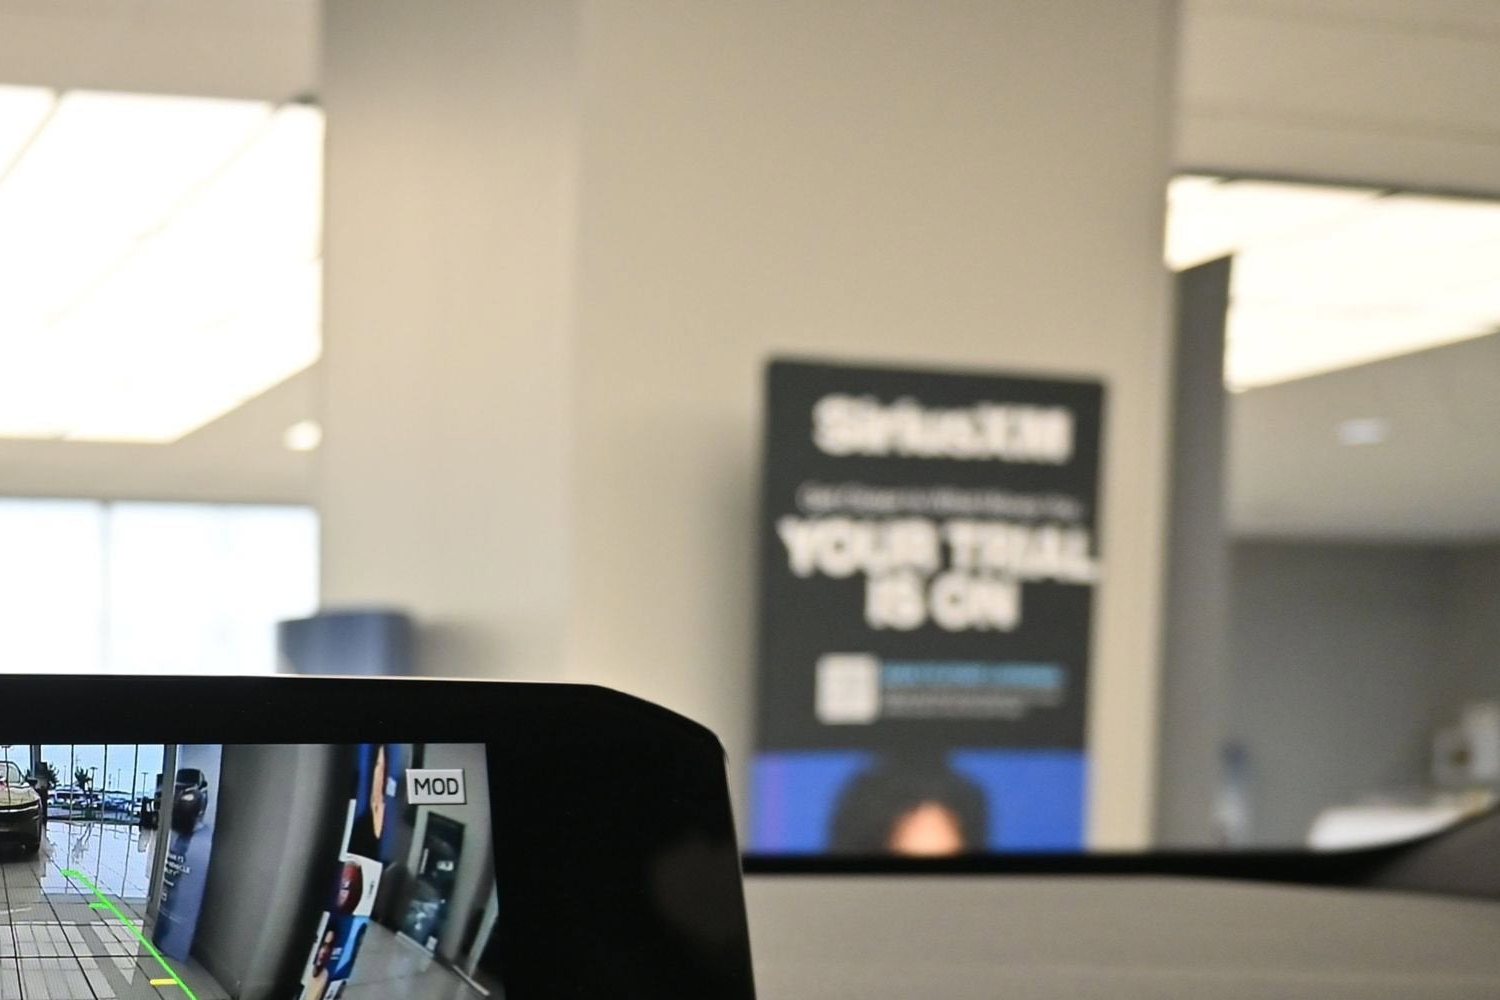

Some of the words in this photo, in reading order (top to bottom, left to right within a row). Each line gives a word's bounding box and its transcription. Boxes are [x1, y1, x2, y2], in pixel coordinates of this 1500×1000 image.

[777, 518, 939, 578] YOUR
[944, 520, 1100, 583] TRIAL
[865, 573, 925, 630] IS
[931, 573, 1021, 631] ON
[414, 778, 458, 795] MOD
